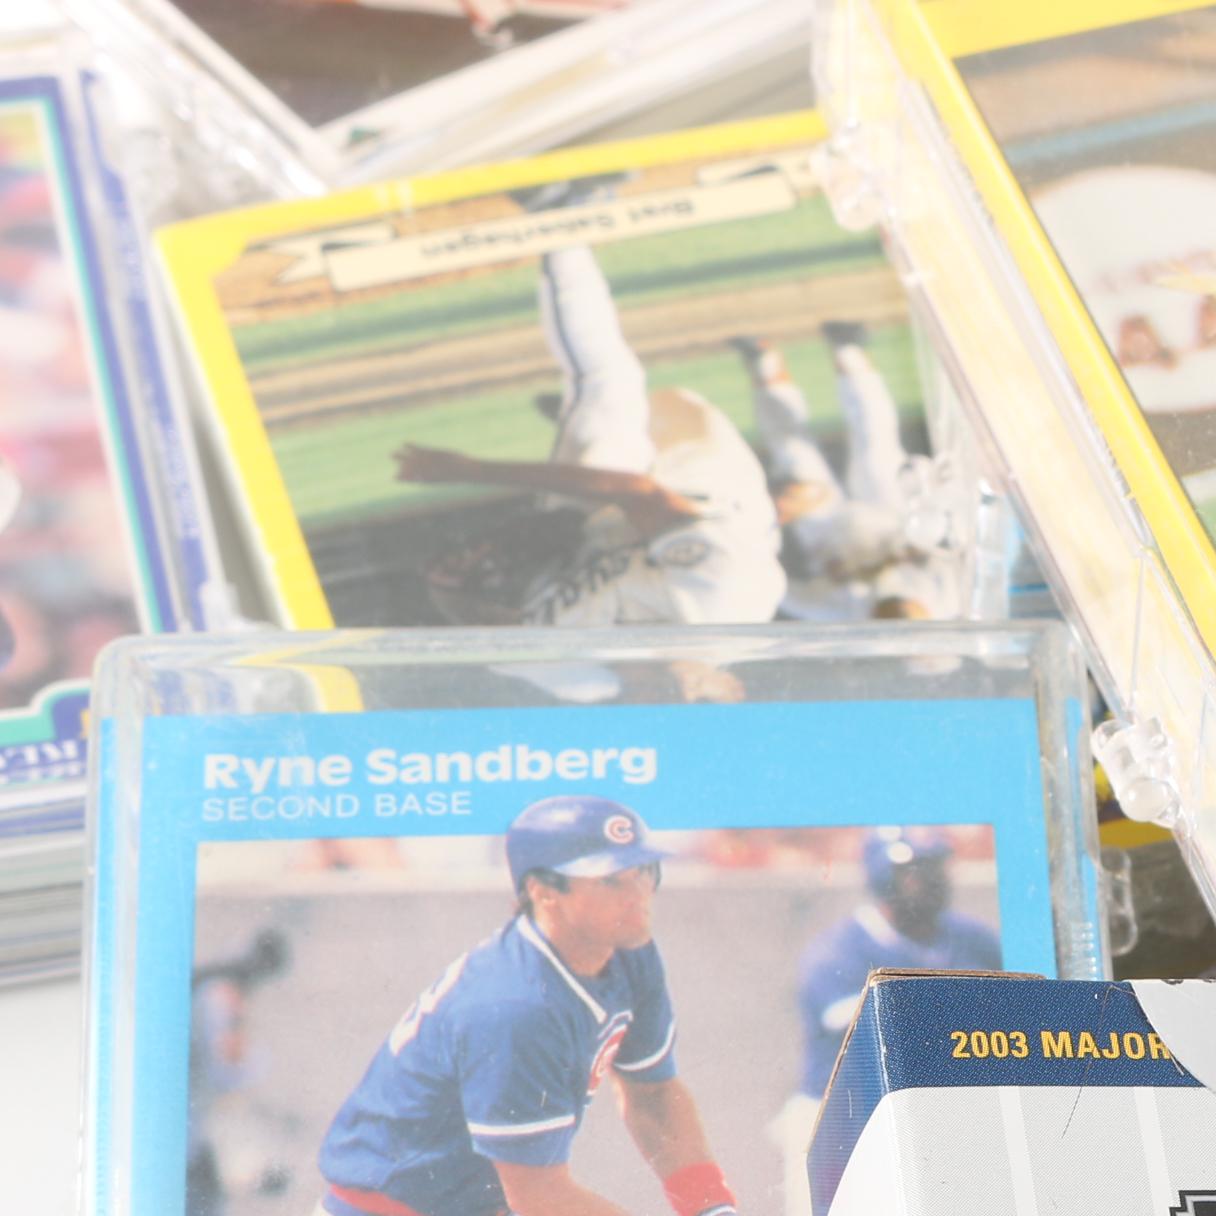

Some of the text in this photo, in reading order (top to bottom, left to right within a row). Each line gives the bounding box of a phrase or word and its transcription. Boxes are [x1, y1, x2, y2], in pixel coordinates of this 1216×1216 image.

[204, 745, 657, 793] Ryne Sandberg
[202, 791, 472, 822] SECOND BASE
[951, 1031, 1029, 1058] 2003
[1040, 1031, 1171, 1059] MAJOR
